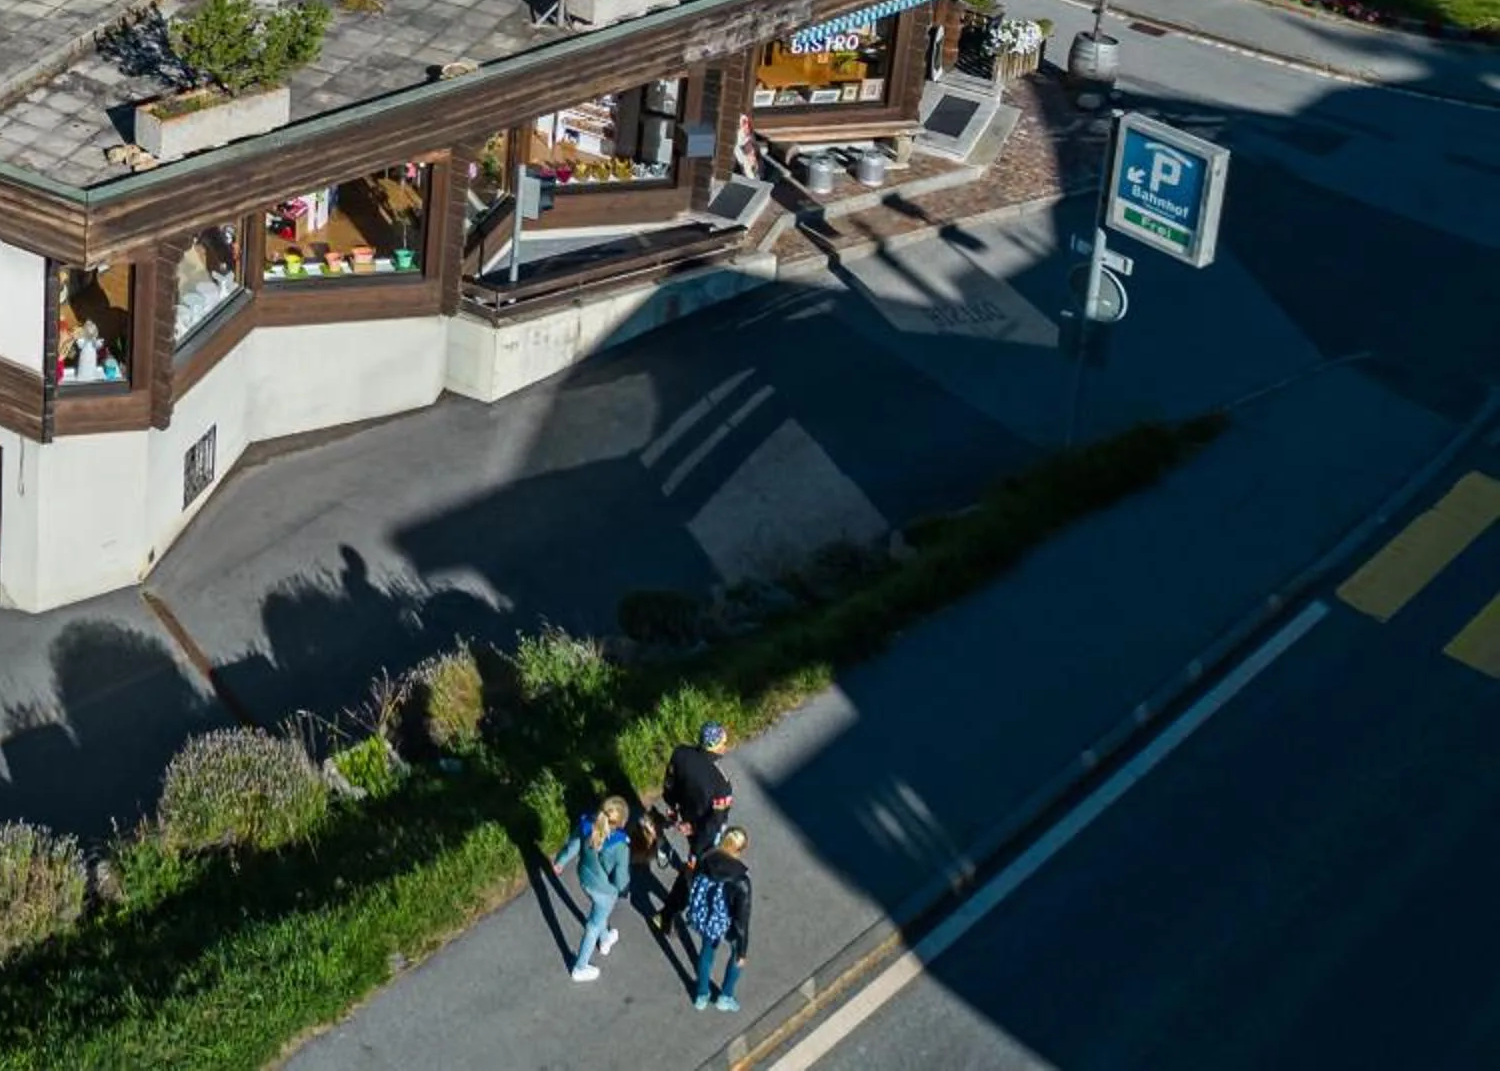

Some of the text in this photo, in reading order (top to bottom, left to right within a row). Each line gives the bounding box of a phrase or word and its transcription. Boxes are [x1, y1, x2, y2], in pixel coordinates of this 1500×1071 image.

[791, 33, 860, 54] BISTRO
[1150, 151, 1181, 193] P
[1131, 184, 1190, 218] Bahnhof
[1141, 215, 1171, 239] Frei
